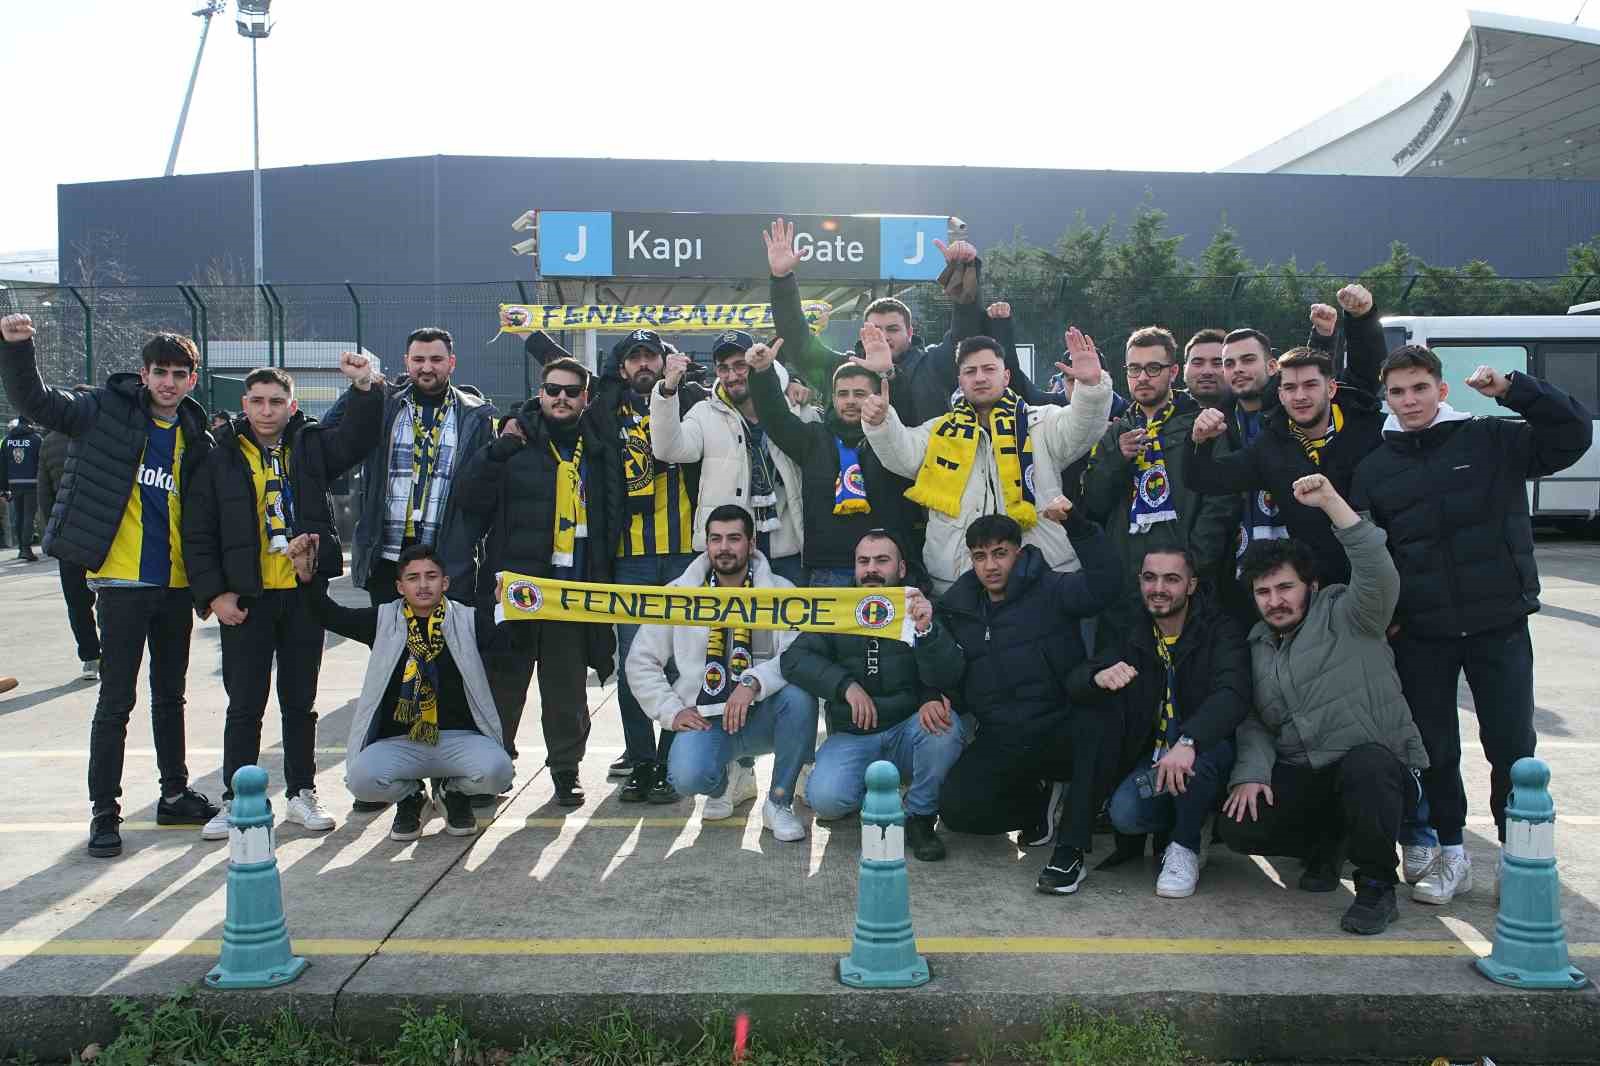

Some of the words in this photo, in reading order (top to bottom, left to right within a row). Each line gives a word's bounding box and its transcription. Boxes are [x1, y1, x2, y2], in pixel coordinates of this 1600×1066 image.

[564, 225, 587, 262] J
[628, 229, 703, 267] Kapı
[793, 232, 865, 263] Gate
[903, 231, 925, 265] J
[136, 463, 179, 496] toko
[560, 588, 837, 631] FENERBAHÇE
